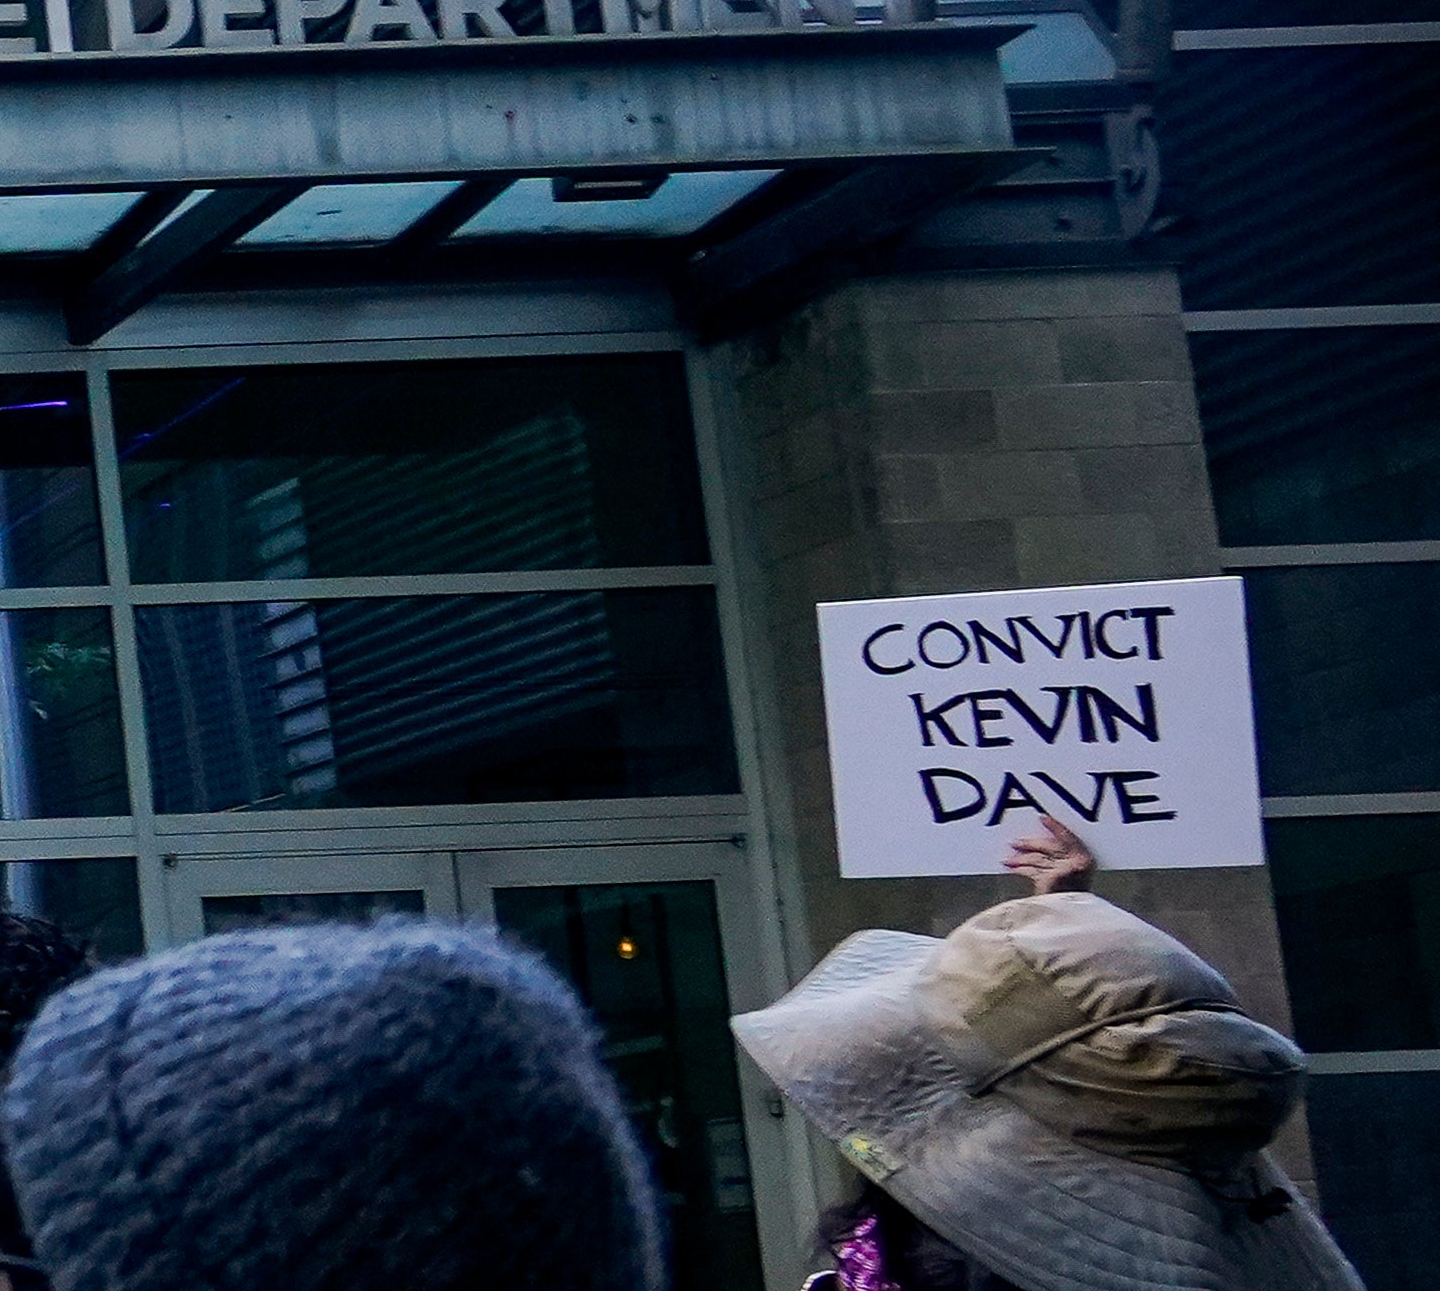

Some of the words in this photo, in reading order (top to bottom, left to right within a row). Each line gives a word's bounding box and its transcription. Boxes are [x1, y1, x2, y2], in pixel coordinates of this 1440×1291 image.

[862, 606, 1175, 675] CONVICT
[908, 683, 1161, 748] KEVIN
[918, 767, 1178, 826] DAVE
